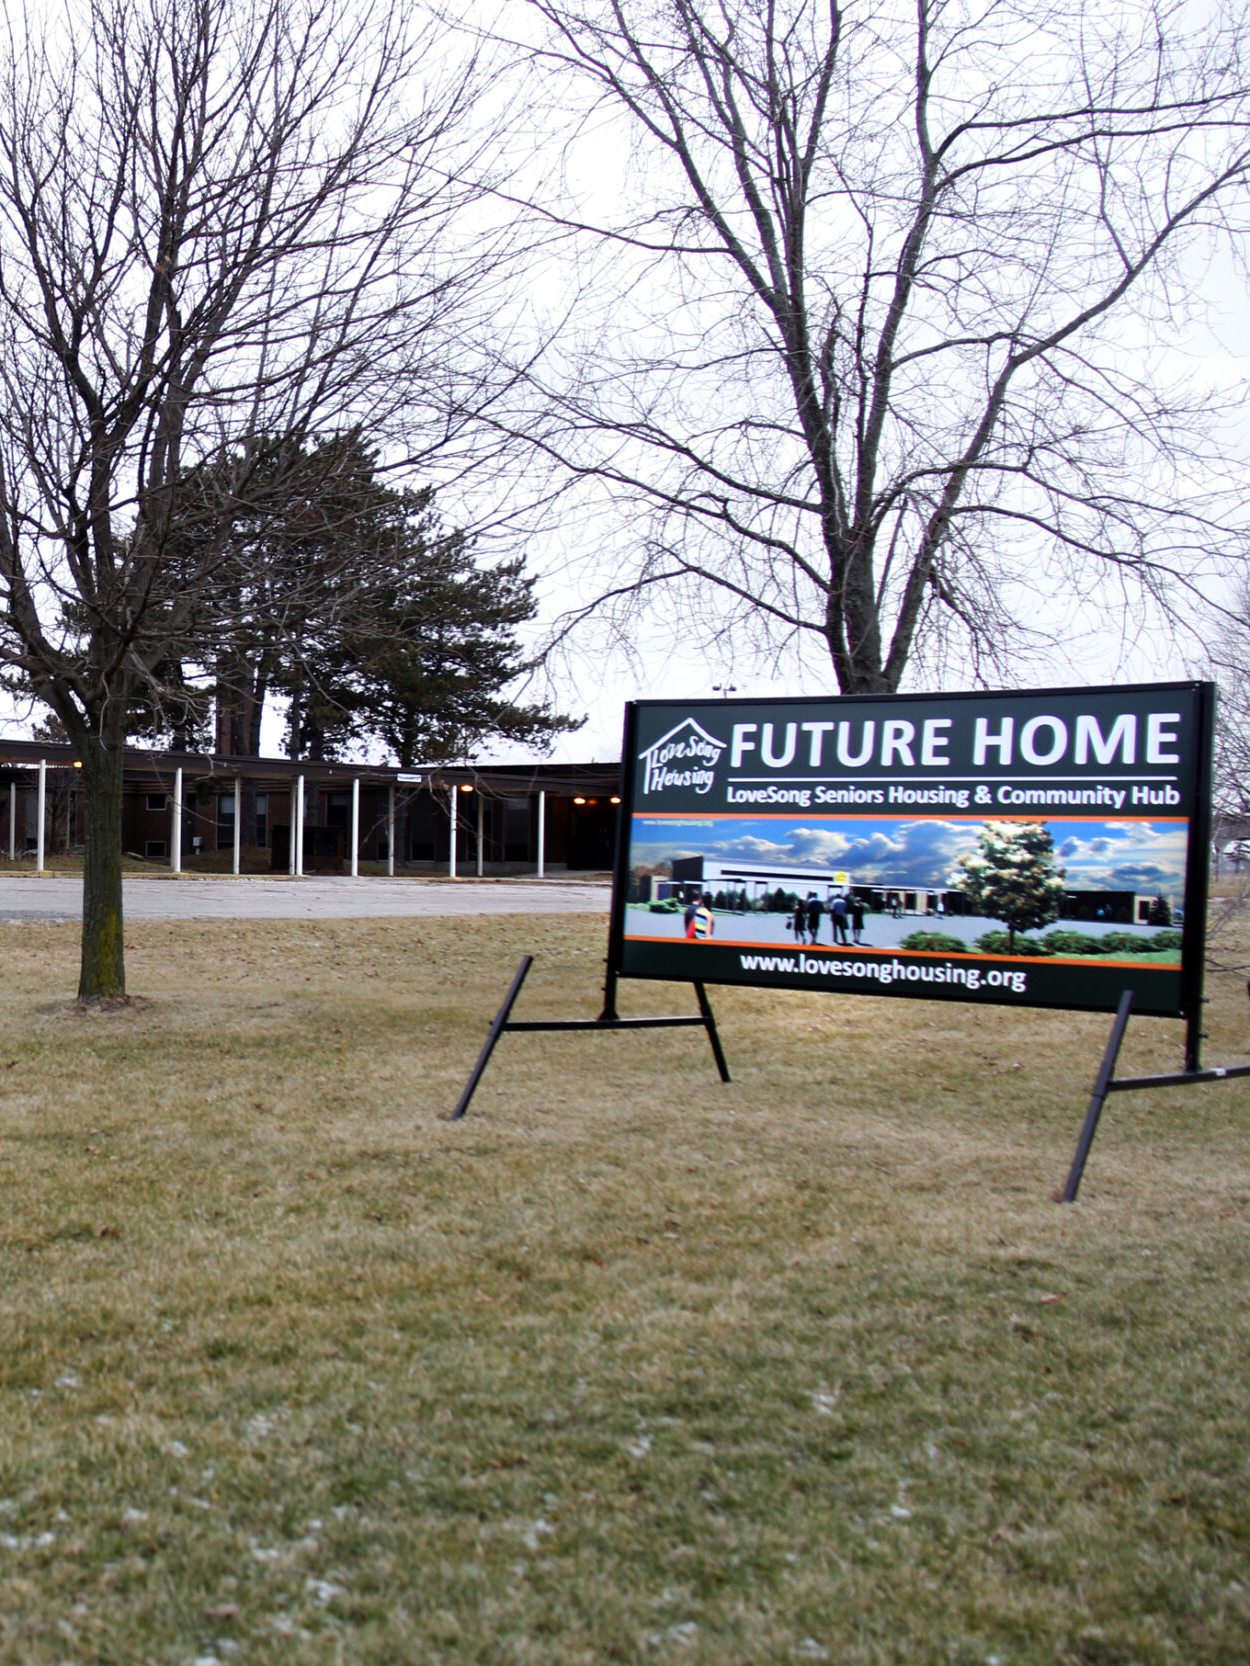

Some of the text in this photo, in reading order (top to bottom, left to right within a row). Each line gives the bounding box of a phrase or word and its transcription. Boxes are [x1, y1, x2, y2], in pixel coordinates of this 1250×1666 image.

[651, 735, 722, 767] LoveSong
[730, 713, 1181, 767] FUTURE HOME
[650, 766, 715, 794] Housing
[726, 784, 1181, 810] LoveSong Seniors Housing & Community Hub
[740, 953, 1027, 992] www.lovesonghousing.org
